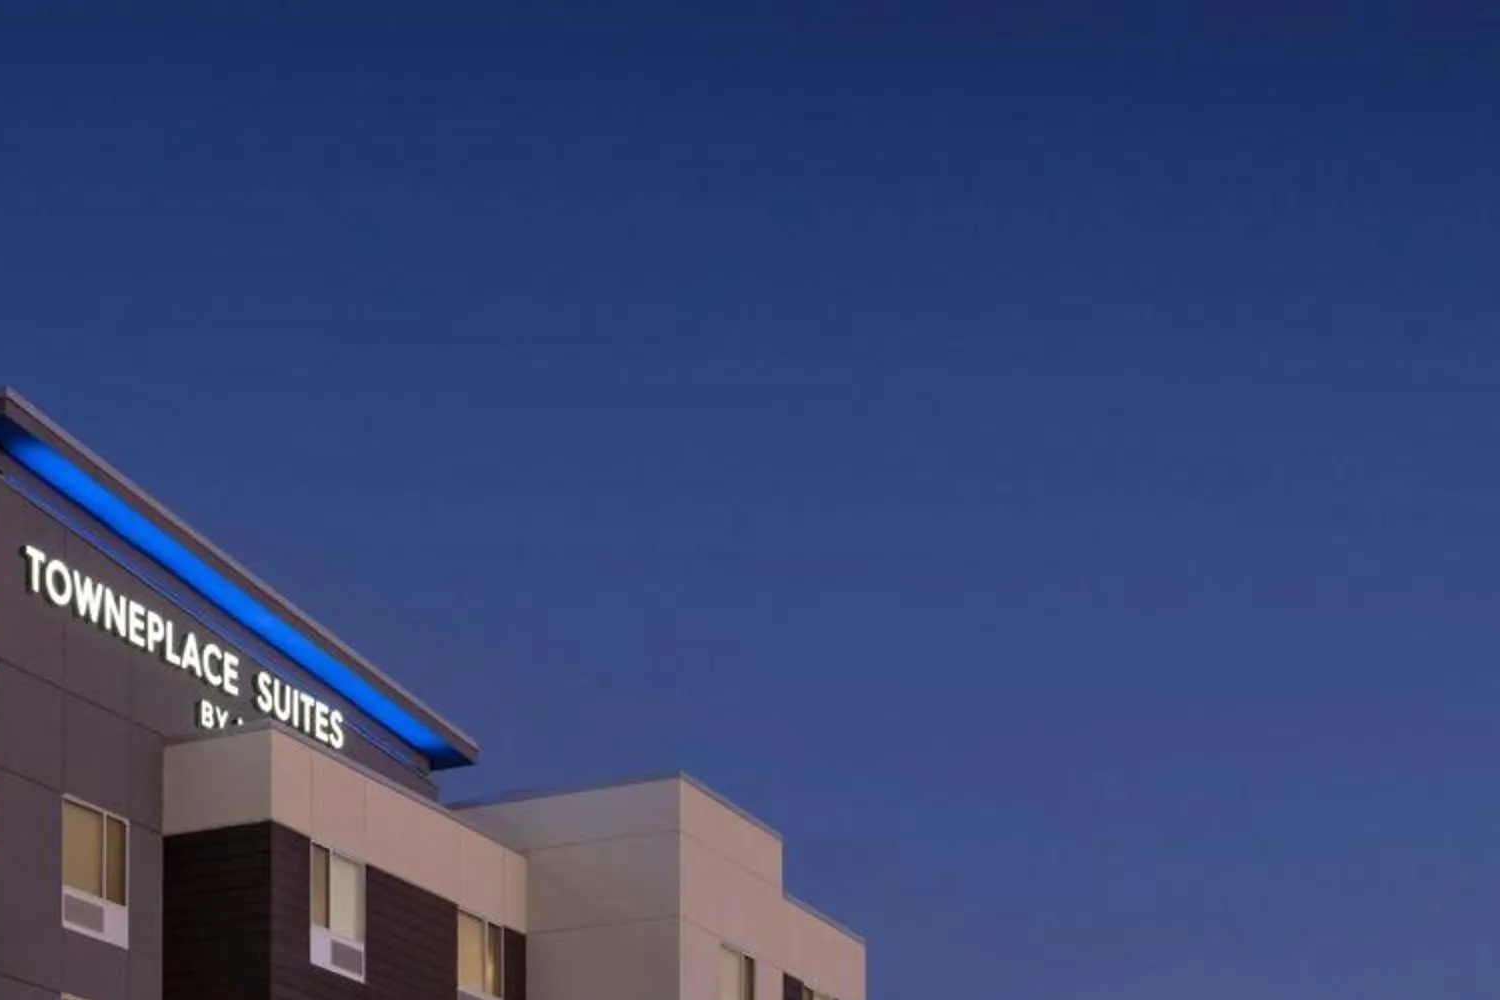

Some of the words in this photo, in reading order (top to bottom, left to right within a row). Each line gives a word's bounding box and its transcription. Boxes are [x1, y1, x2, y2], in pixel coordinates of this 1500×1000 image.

[24, 544, 240, 697] TOWNEPLACE
[256, 670, 345, 750] SUITES
[200, 698, 229, 729] BY
